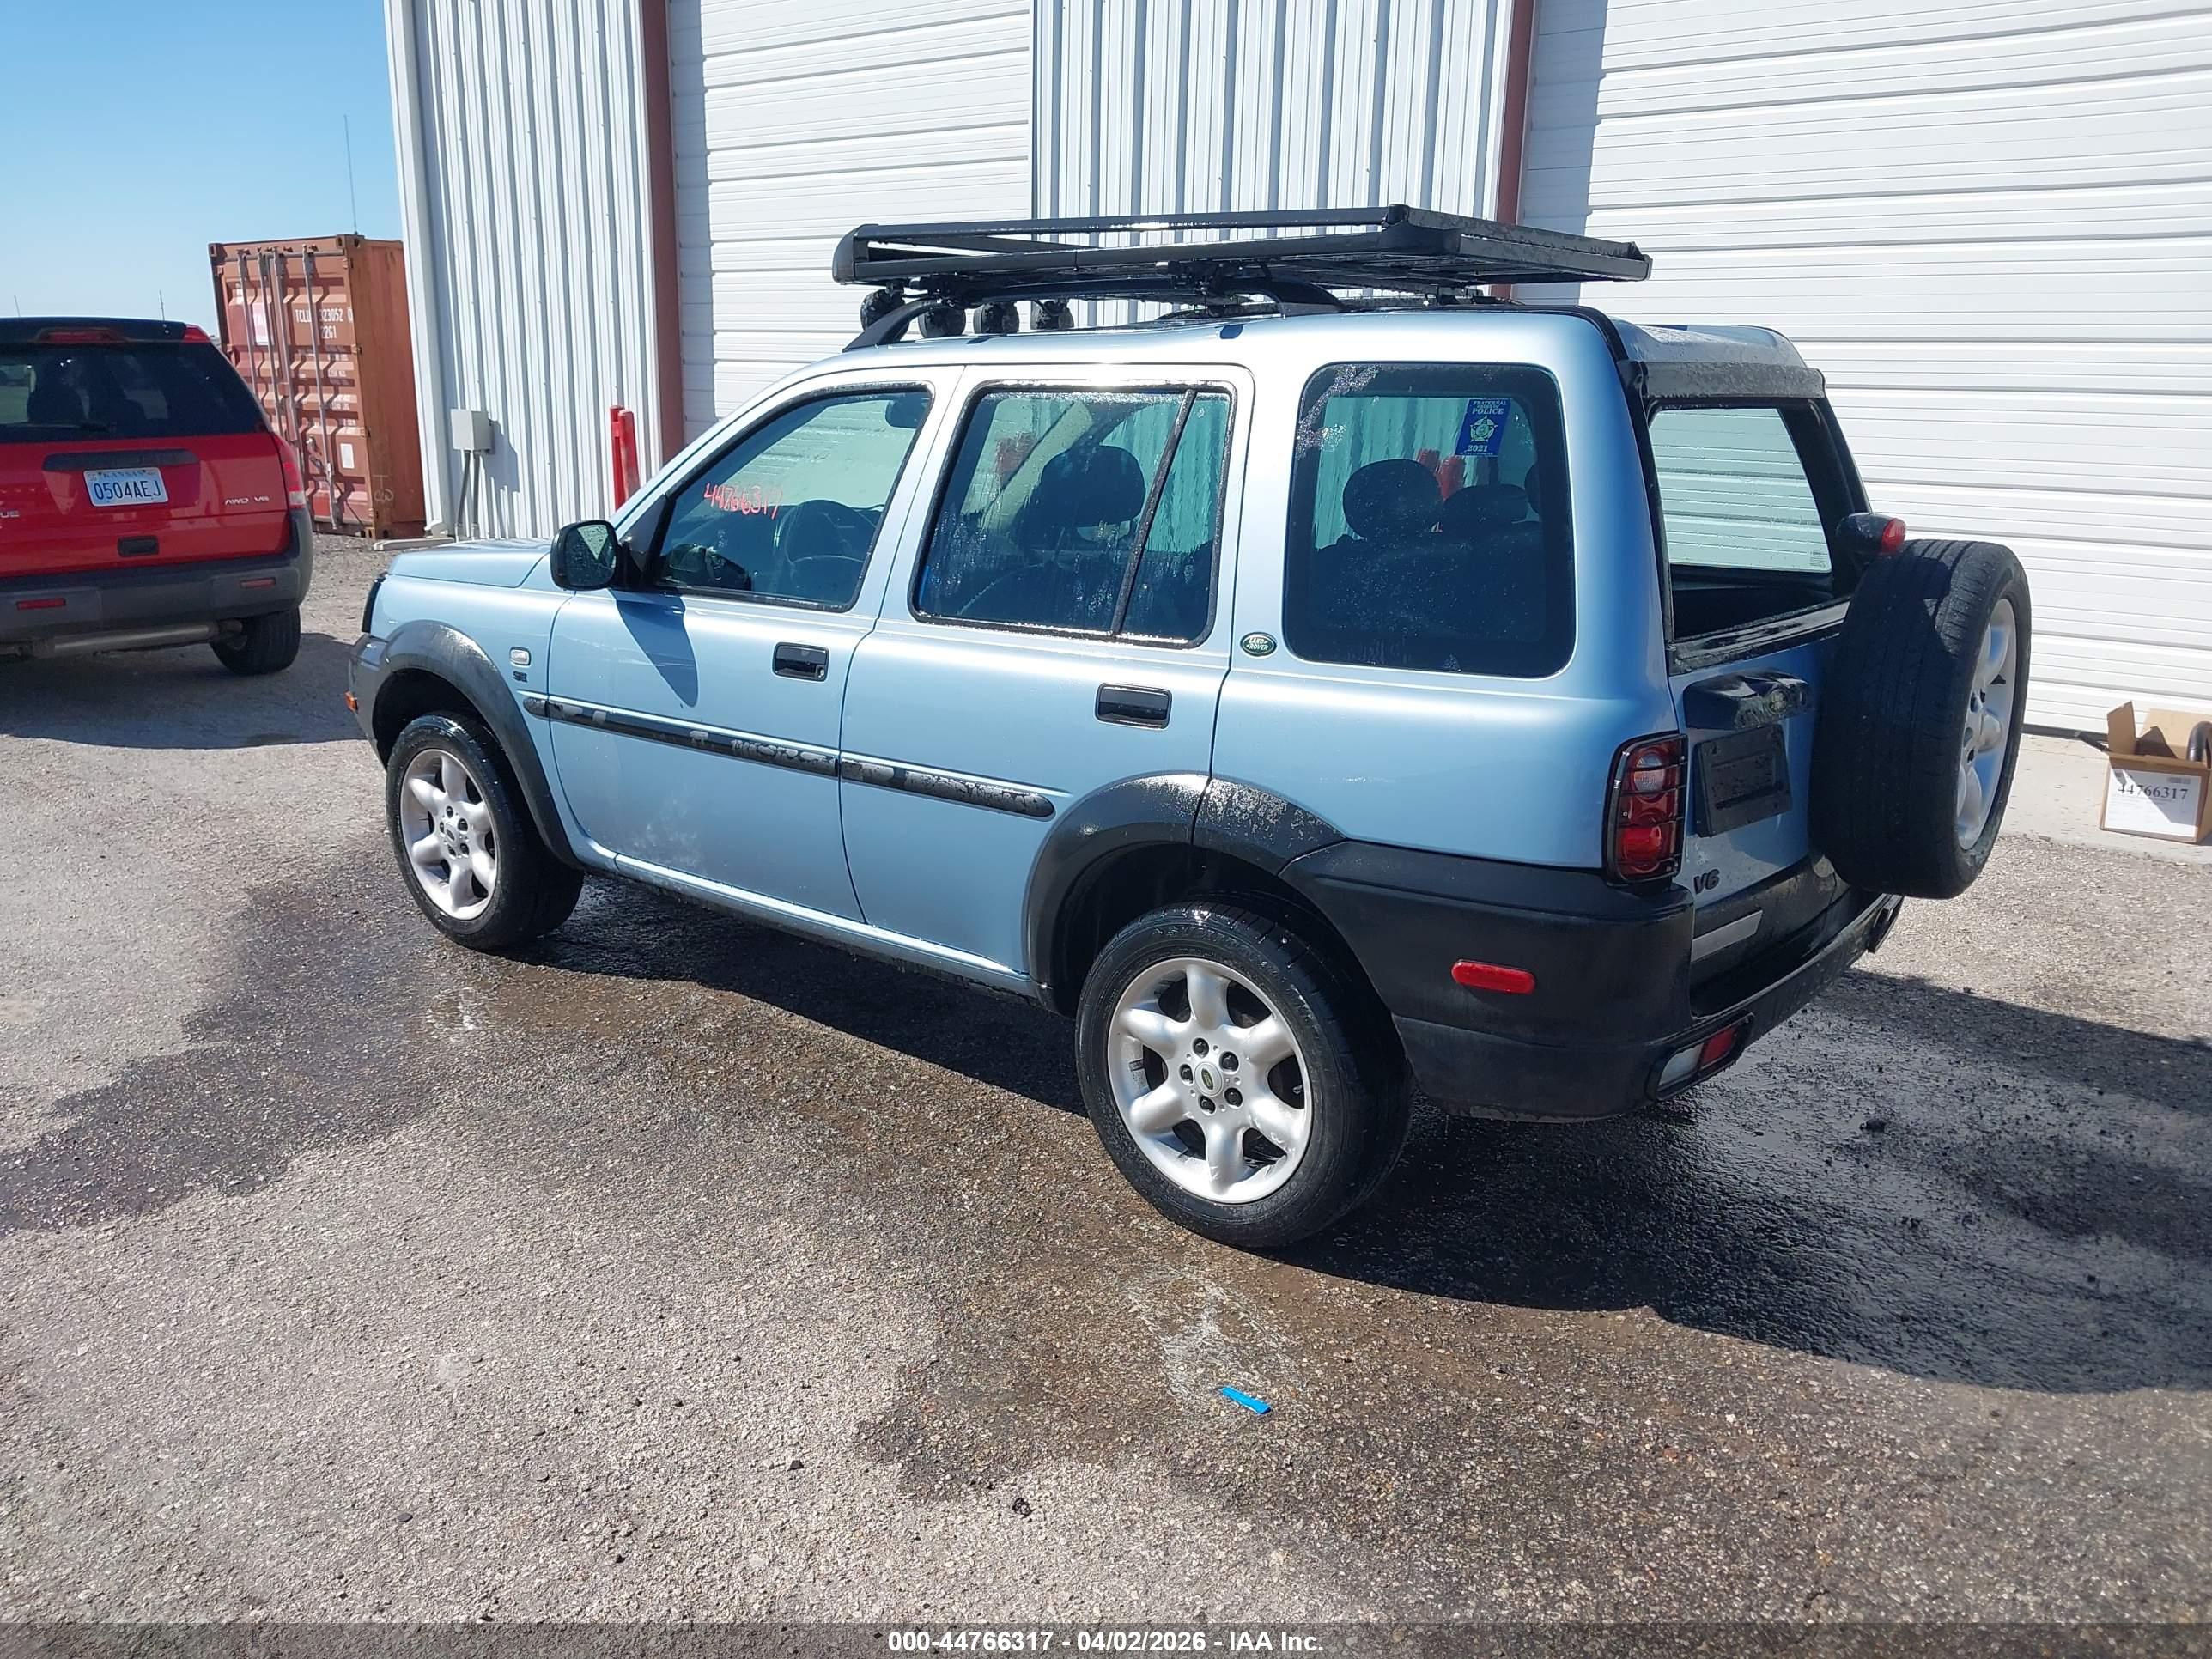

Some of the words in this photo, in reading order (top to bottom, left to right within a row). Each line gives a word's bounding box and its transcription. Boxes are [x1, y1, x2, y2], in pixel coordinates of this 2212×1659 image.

[103, 471, 145, 479] KANSAS
[94, 481, 161, 500] 0504AEJ
[704, 483, 783, 520] 44766317
[2118, 784, 2189, 799] 44766317
[1693, 869, 1720, 894] V6
